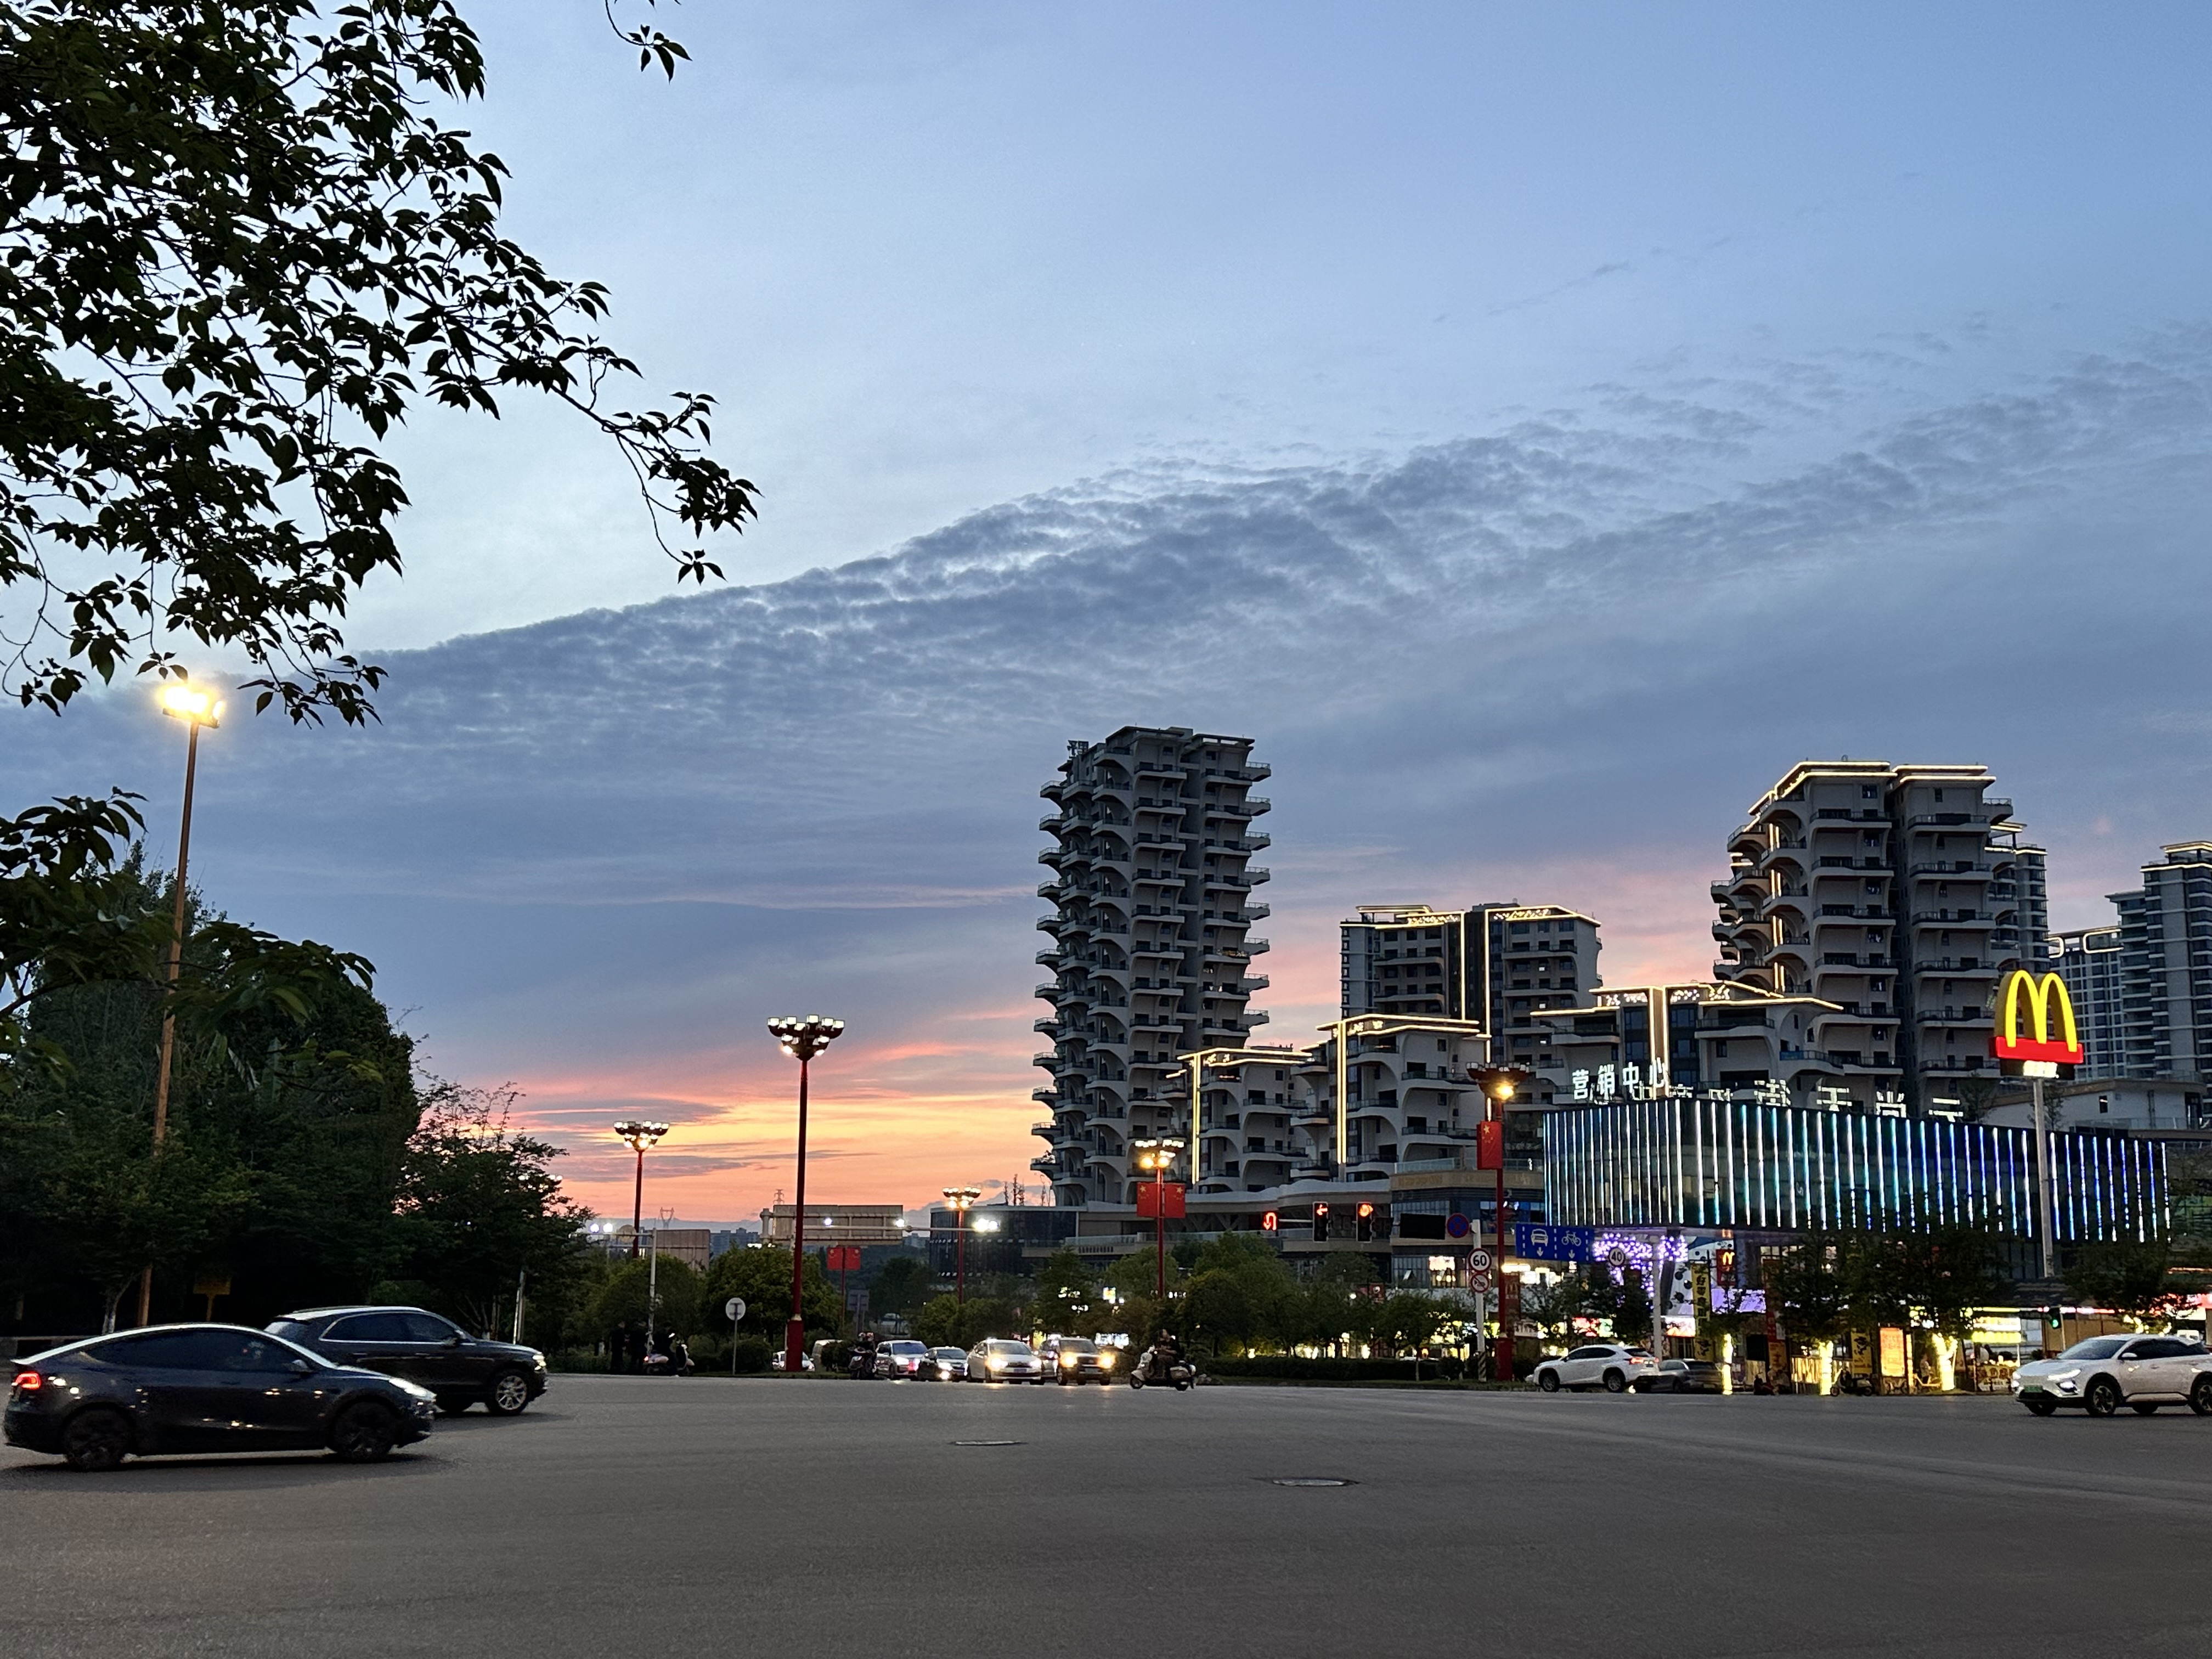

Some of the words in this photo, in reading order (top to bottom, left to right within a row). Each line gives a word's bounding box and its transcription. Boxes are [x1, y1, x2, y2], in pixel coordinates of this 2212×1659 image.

[1572, 1057, 1665, 1099] 营销中心
[1473, 1255, 1487, 1266] 60
[1611, 1251, 1622, 1262] 40
